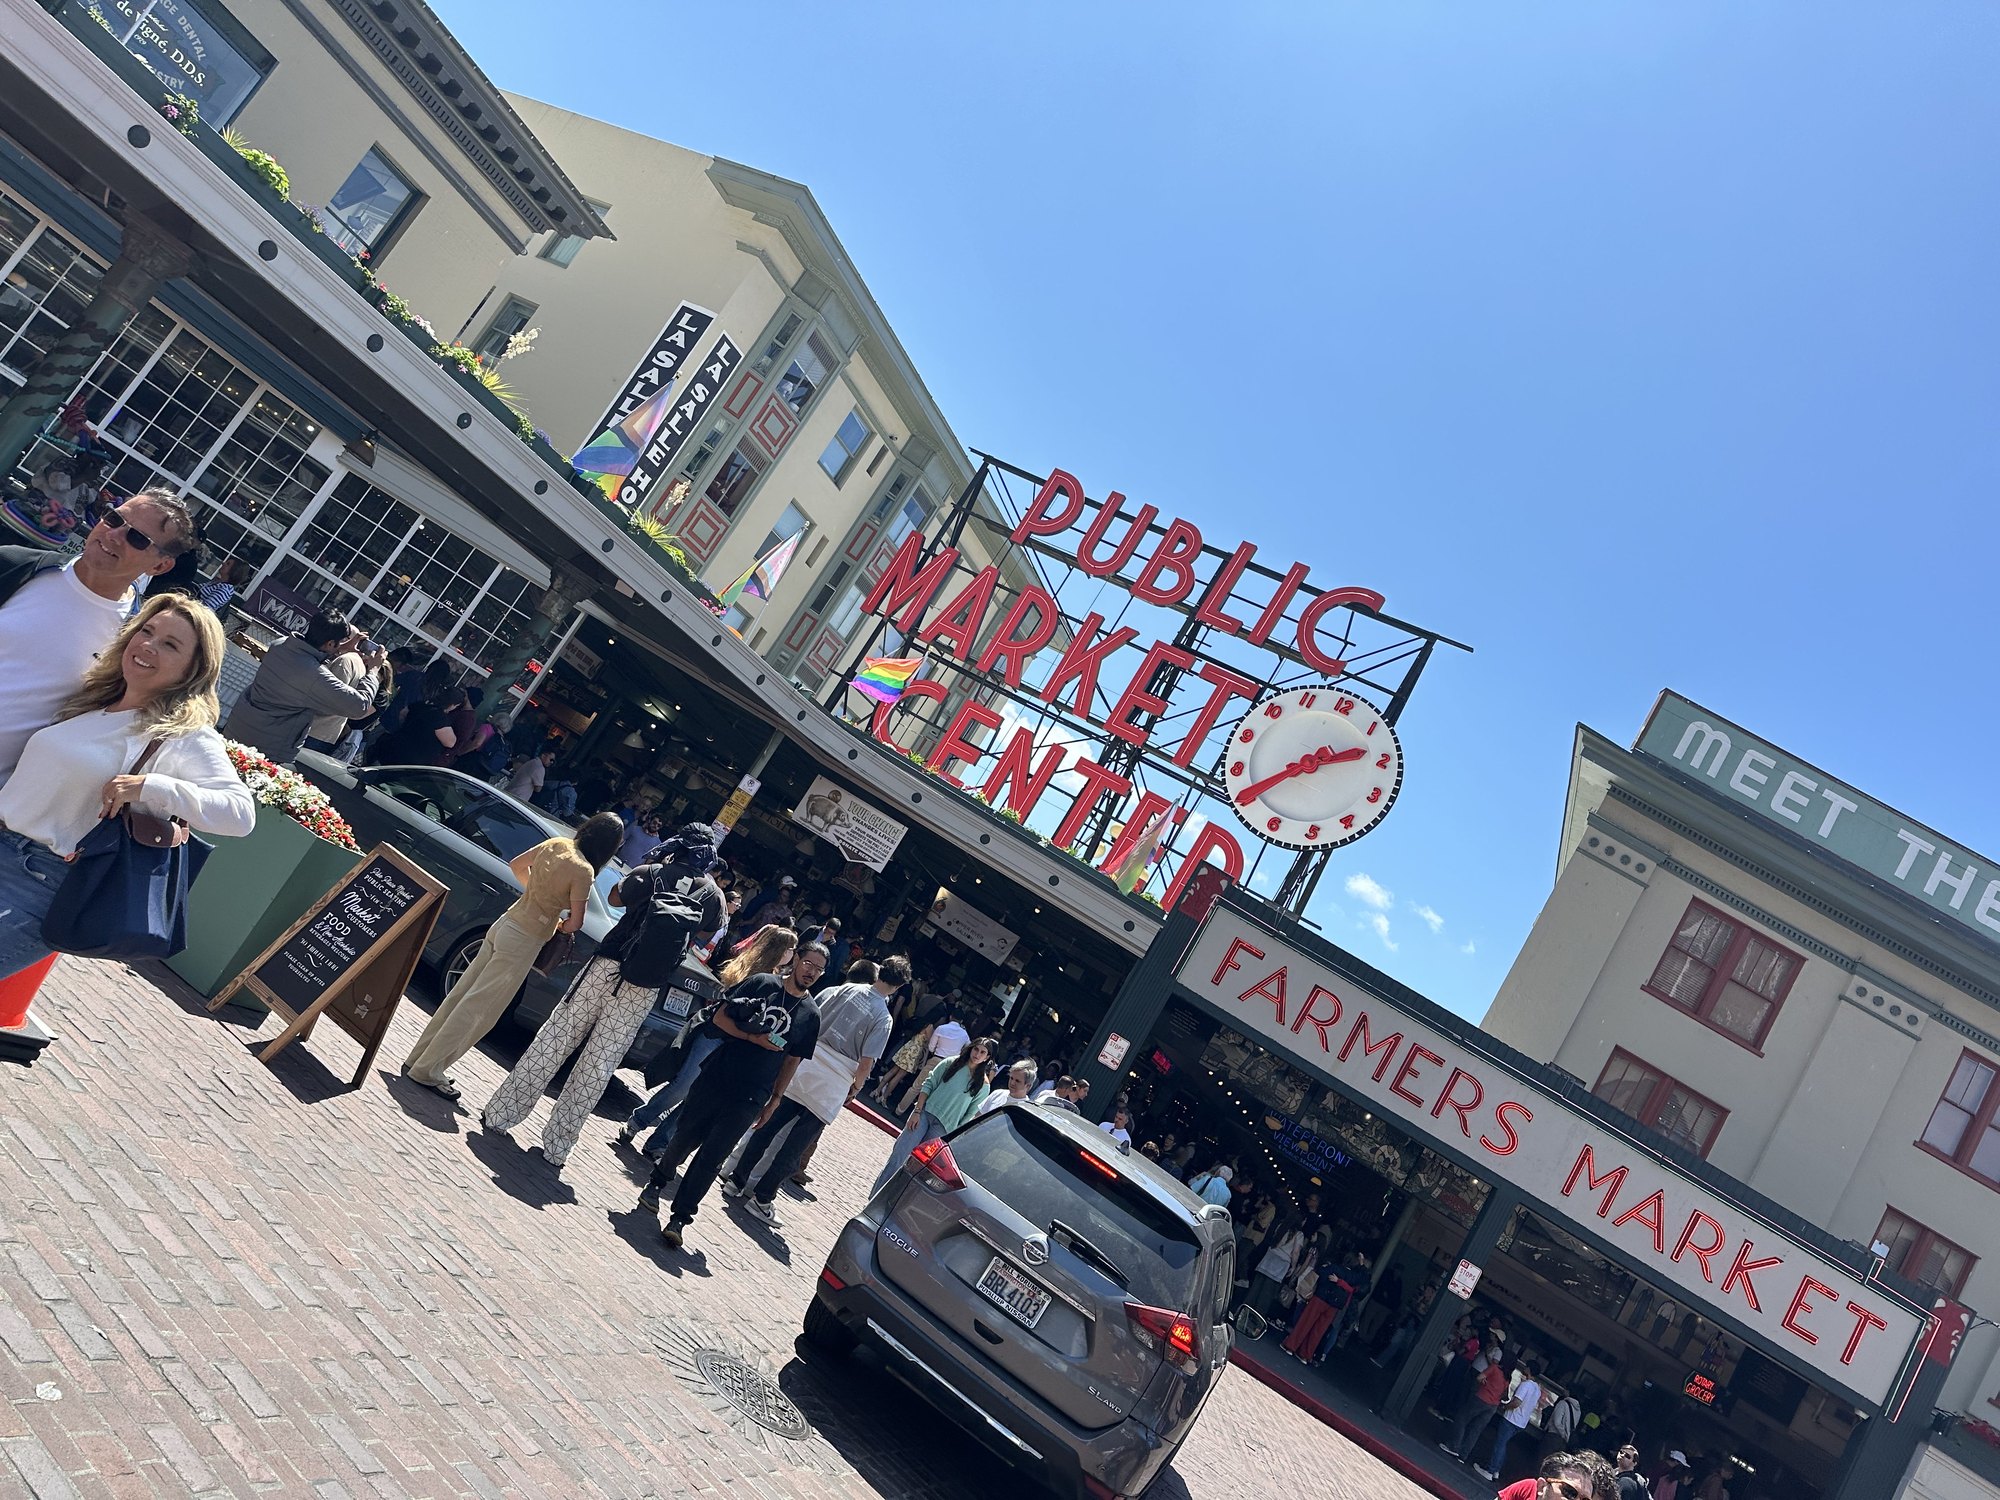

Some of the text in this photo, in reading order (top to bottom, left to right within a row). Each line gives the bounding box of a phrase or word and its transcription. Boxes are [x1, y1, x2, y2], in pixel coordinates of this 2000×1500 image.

[116, 0, 133, 17] de
[170, 49, 206, 87] D.D.S.
[177, 16, 208, 61] DENTAL
[155, 70, 185, 90] STRY
[665, 313, 698, 348] LA
[705, 341, 731, 384] LA
[646, 382, 710, 468] SALLE
[1010, 468, 1385, 677] PUBLIC
[861, 531, 1261, 770] MARKET
[1264, 702, 1282, 720] 10
[1299, 692, 1317, 708] 11
[1334, 697, 1355, 715] 12
[1239, 729, 1254, 743] 9
[1367, 721, 1377, 736] 1
[1230, 761, 1244, 776] 8
[1375, 753, 1391, 769] 2
[1672, 721, 1858, 839] MEET
[872, 679, 1245, 913] CENTER
[1366, 787, 1382, 803] 3
[847, 801, 903, 840] YOUR CHANGE
[851, 816, 878, 834] CHANGES
[877, 832, 896, 845] LIVES!
[1267, 817, 1281, 832] 6
[1304, 825, 1320, 840] 5
[1339, 814, 1355, 829] 4
[837, 839, 858, 853] DONATE
[364, 874, 407, 908] PUBLIC SEATING
[340, 891, 382, 924] Market
[323, 912, 351, 936] FOOD
[346, 912, 378, 938] CUSTOMERS
[309, 927, 351, 962] BEVERAGES WELCOME
[283, 951, 297, 964] PLEASE
[296, 961, 309, 974] CLEAN
[313, 976, 326, 987] AFTER
[287, 963, 311, 983] YOURSELVES
[1109, 1041, 1124, 1053] STOPS
[1211, 936, 1888, 1366] FARMERS MARKET
[882, 1226, 919, 1258] ROGUE
[994, 1264, 1026, 1291] WASHINGTON
[1460, 1268, 1476, 1281] STOPS
[978, 1285, 1033, 1327] PUYALLUP NISSAN
[981, 1270, 1040, 1320] BRL4103
[1685, 1382, 1716, 1403] GROCERY
[1694, 1374, 1715, 1390] ROTARY
[1087, 1385, 1122, 1414] SL AWD
